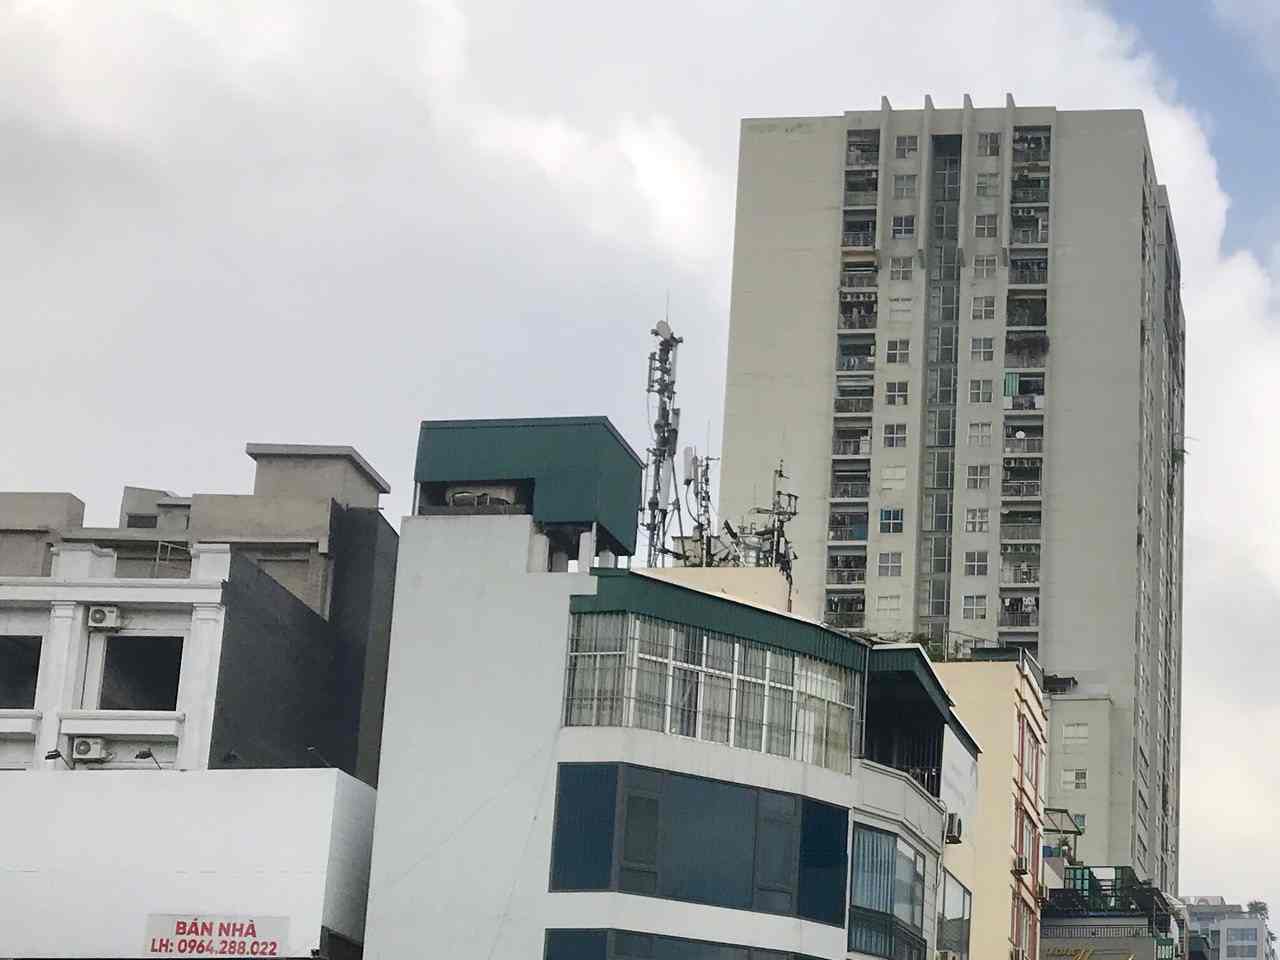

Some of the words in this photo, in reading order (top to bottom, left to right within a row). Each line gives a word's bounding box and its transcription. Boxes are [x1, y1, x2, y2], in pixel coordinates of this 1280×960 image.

[175, 918, 212, 936] BÁN
[218, 919, 257, 938] NHÀ
[151, 938, 173, 953] LH:
[177, 939, 278, 956] 0964.288.022
